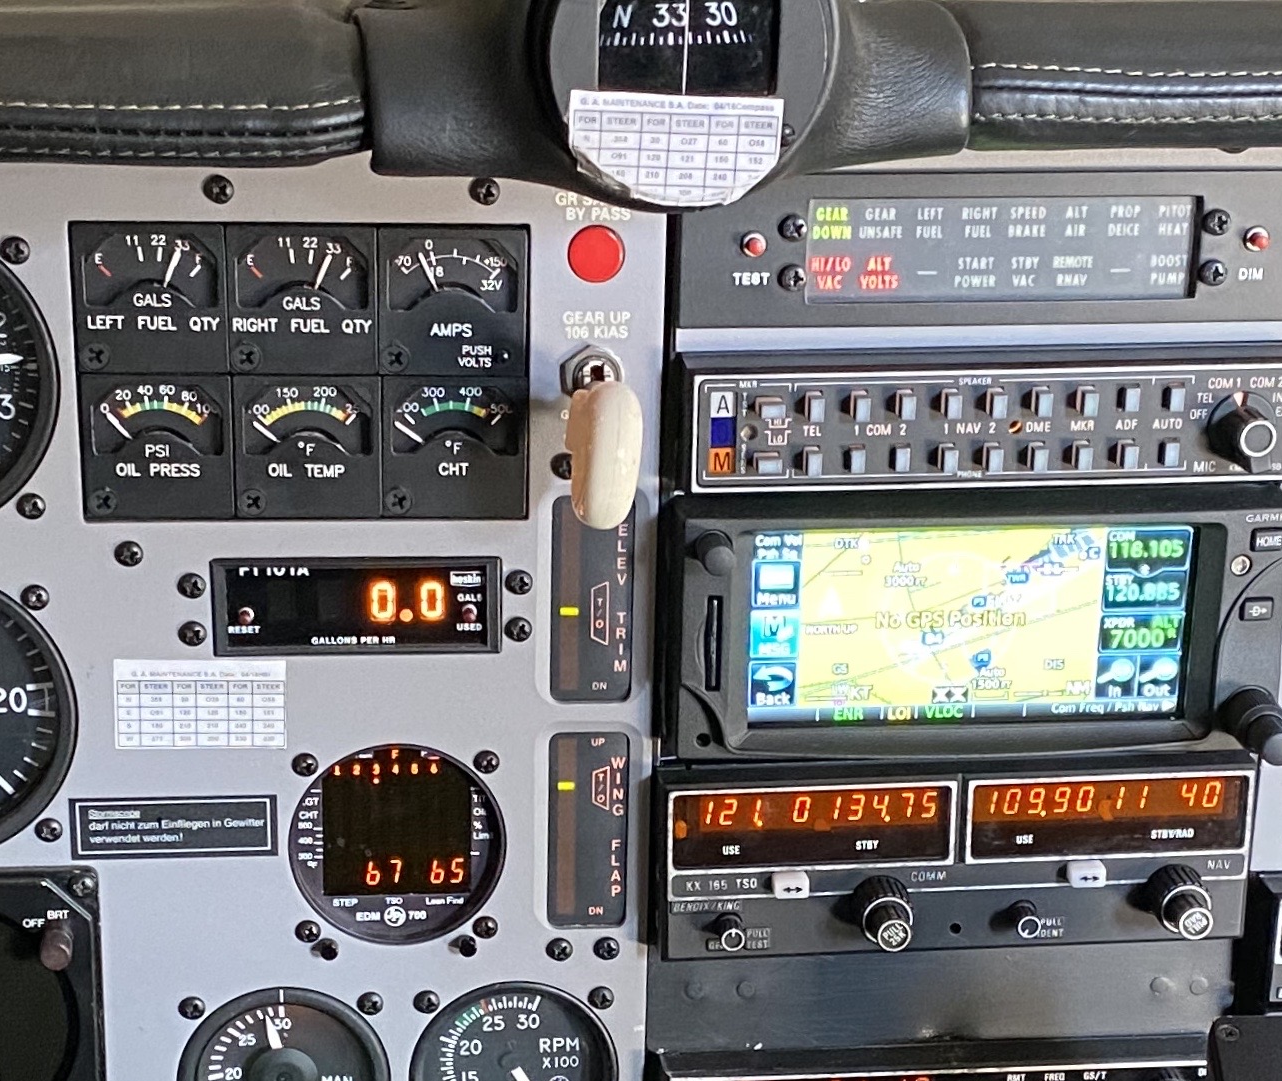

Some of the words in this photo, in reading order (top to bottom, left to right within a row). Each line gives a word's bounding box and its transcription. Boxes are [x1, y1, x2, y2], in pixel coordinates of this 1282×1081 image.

[613, 5, 632, 28] N
[653, 4, 686, 27] 33
[705, 2, 737, 26] 30
[565, 206, 586, 221] BY
[592, 207, 630, 221] PASS
[816, 207, 848, 221] GEAR
[865, 207, 897, 221] GEAR
[917, 207, 944, 221] LEFT
[961, 206, 998, 220] RIGHT
[1010, 206, 1047, 220] SPEED
[812, 225, 851, 239] DOWN
[858, 225, 903, 239] UNSAFE
[915, 225, 943, 239] FUEL
[964, 224, 992, 239] FUEL
[1007, 224, 1046, 238] BRAKE
[867, 256, 892, 271] ALT
[957, 256, 995, 270] START
[732, 271, 771, 286] TEST
[954, 274, 996, 288] POWER
[1238, 267, 1264, 281] DIM
[859, 275, 898, 290] VOLTS
[87, 315, 124, 329] LEFT
[138, 316, 177, 330] FUEL
[189, 317, 219, 331] QTY
[562, 310, 605, 325] GEAR
[609, 310, 631, 324] UP
[233, 318, 278, 332] RIGHT
[291, 319, 329, 333] FUEL
[342, 319, 372, 333] QTY
[430, 323, 472, 337] AMPS
[564, 325, 589, 339] 106
[594, 325, 629, 339] KIAS
[461, 344, 492, 356] PUSH
[457, 356, 492, 368] VOLTS
[802, 424, 822, 437] TEL
[1025, 421, 1051, 433] DME
[1070, 419, 1095, 432] MKR
[1115, 418, 1139, 431] ADF
[1152, 417, 1183, 430] AUTO
[115, 462, 142, 477] OIL
[150, 463, 200, 477] PRESS
[269, 463, 292, 477] OIL
[304, 463, 346, 478] TEMP
[438, 462, 469, 476] CHT
[1256, 532, 1282, 547] HOME
[367, 578, 446, 625] 0.0
[905, 610, 946, 629] GPS
[310, 635, 358, 646] GALLONS
[359, 635, 380, 645] PER
[381, 635, 396, 644] HR
[1110, 629, 1164, 648] 7000
[925, 705, 963, 720] VLOC
[833, 789, 937, 822] 134.75
[990, 784, 1095, 817] 109.90
[111, 821, 135, 830] nicht
[137, 821, 160, 830] zum
[211, 819, 222, 828] in
[1207, 859, 1231, 870] NAV
[540, 1038, 579, 1053] RPM
[542, 1055, 580, 1070] X100
[1044, 1072, 1066, 1081] FREQ
